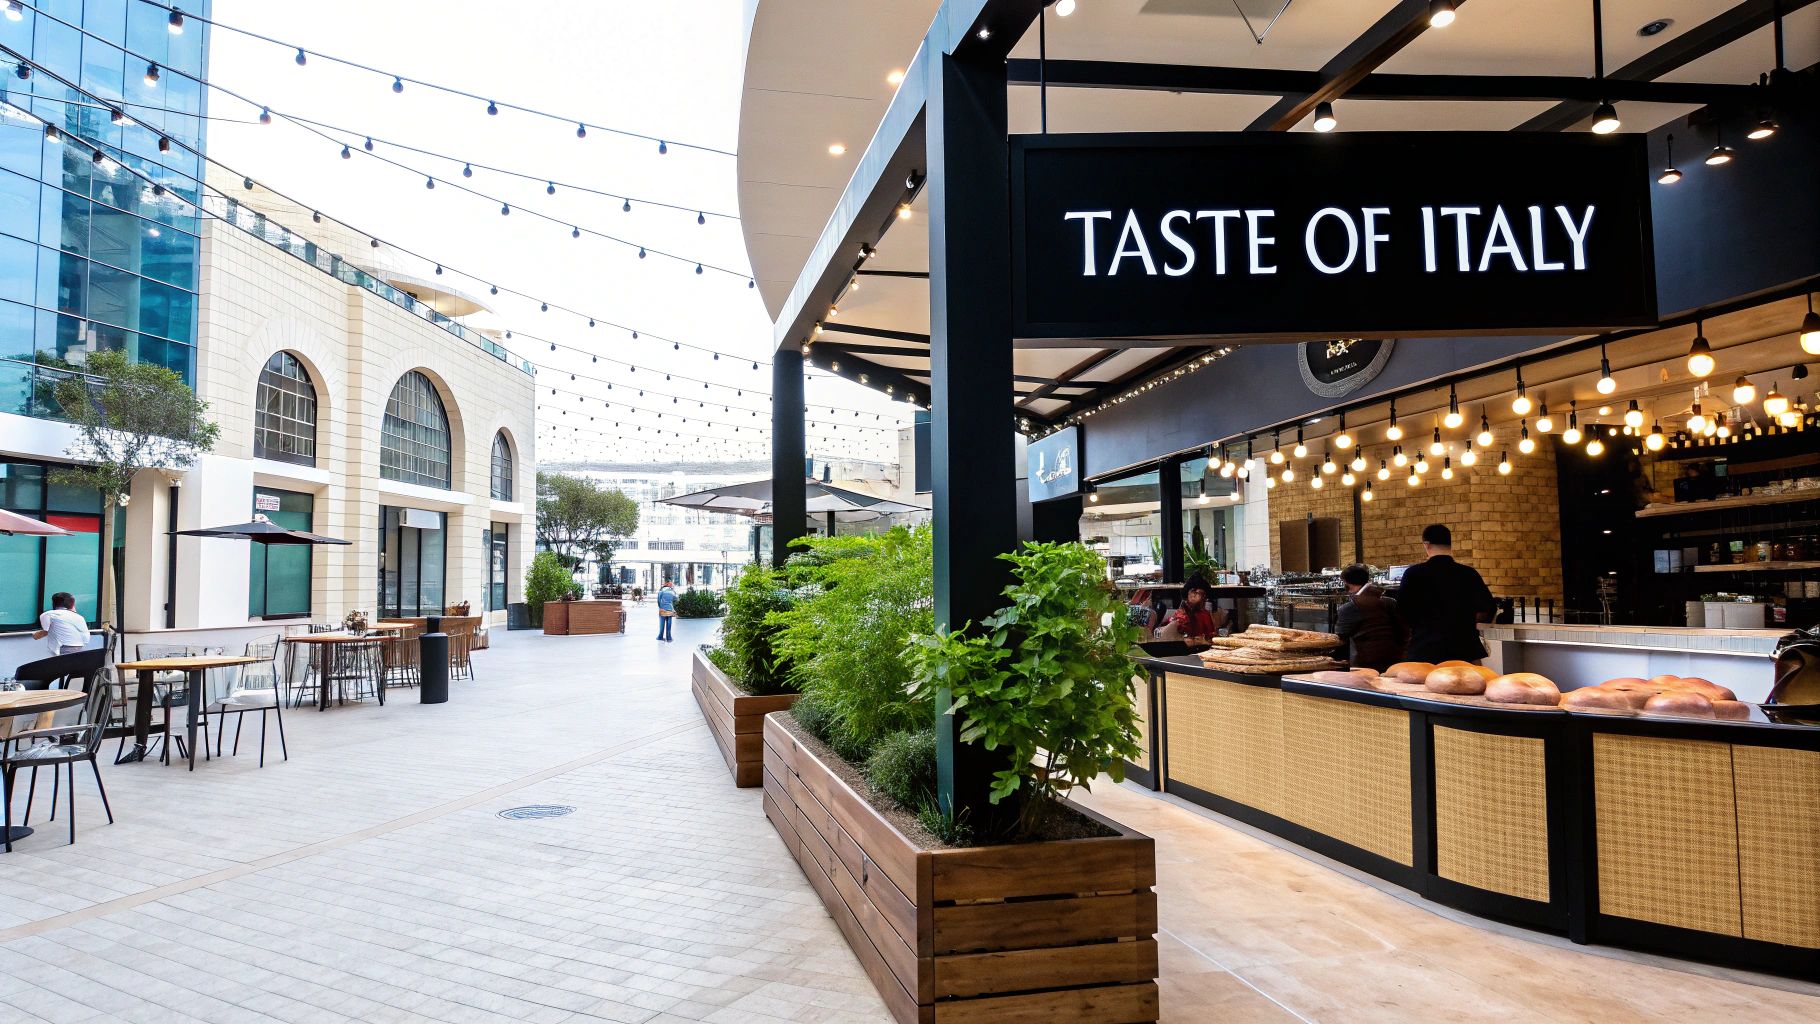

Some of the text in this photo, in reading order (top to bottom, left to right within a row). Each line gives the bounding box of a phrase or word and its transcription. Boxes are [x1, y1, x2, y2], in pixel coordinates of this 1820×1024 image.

[1063, 205, 1596, 276] TASTE OF ITALY
